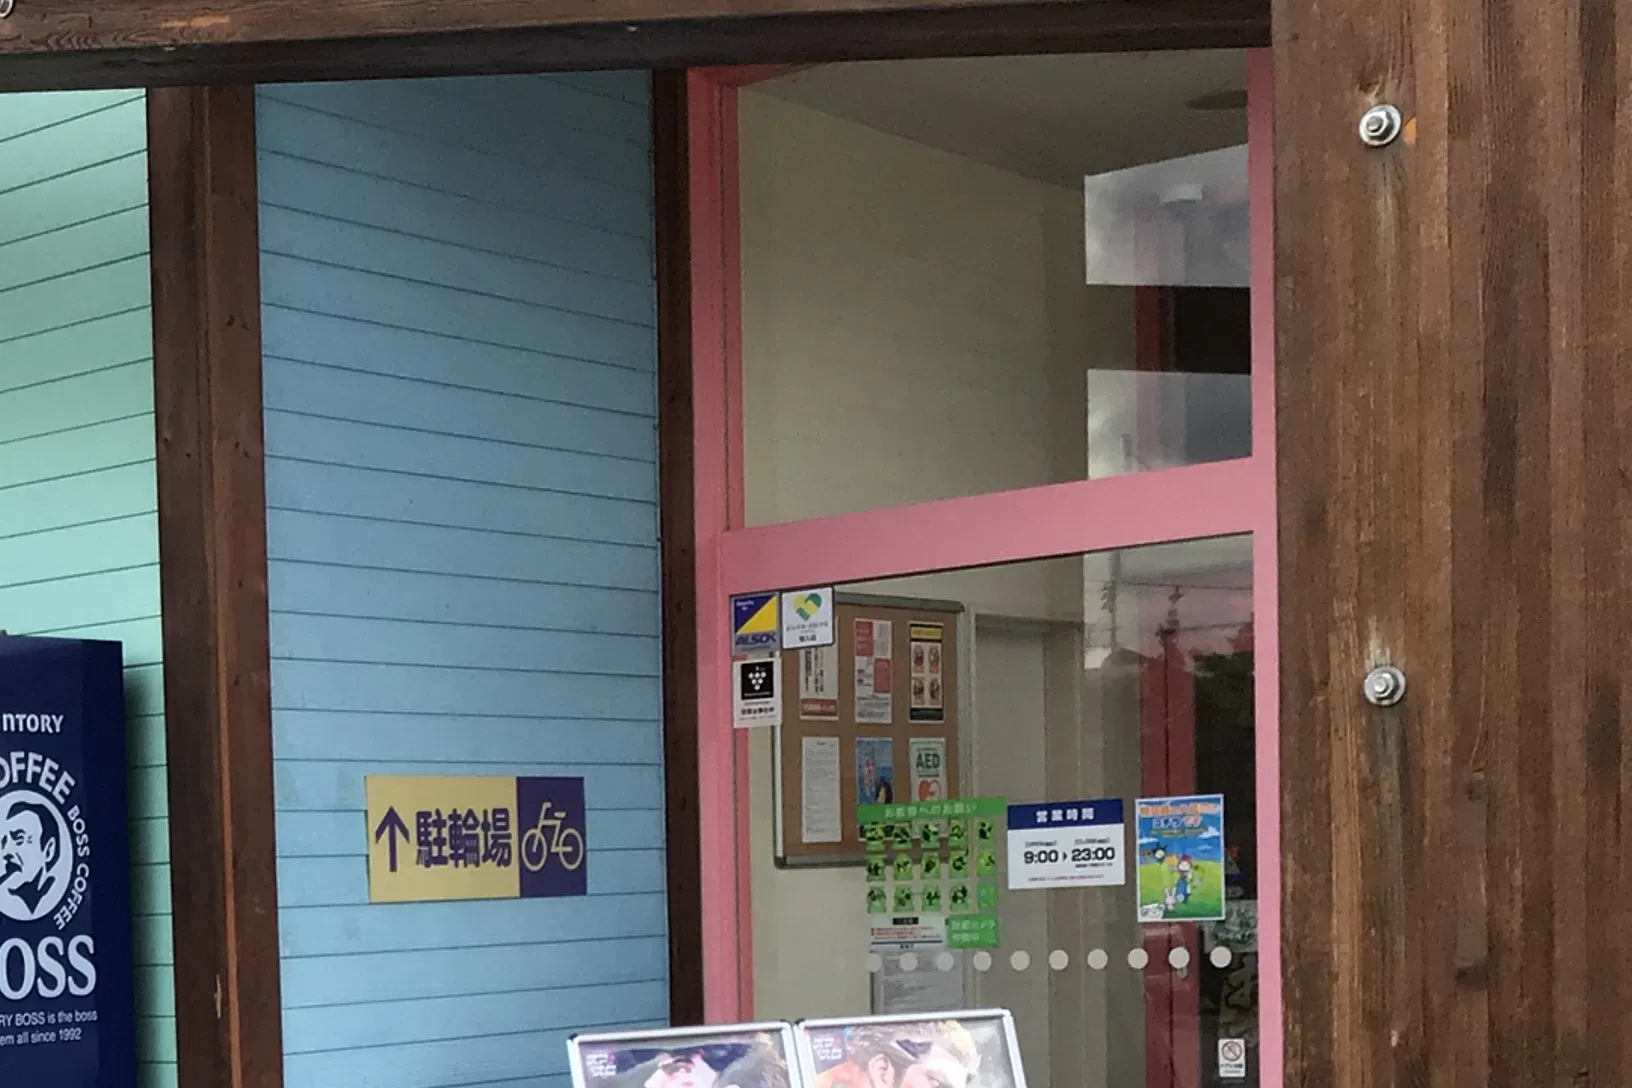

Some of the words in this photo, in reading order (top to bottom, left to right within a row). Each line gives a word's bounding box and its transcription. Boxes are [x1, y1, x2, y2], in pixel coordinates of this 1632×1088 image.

[916, 752, 940, 769] AED
[1036, 807, 1095, 823] 営業時間
[67, 804, 90, 858] BOSS
[415, 807, 513, 868] 駐輪場
[1023, 850, 1059, 864] 9:00
[1071, 847, 1116, 863] 23:00
[53, 862, 90, 931] COFFEE
[15, 1012, 45, 1028] BOSS
[47, 1011, 56, 1025] is
[57, 1010, 74, 1024] the
[75, 1008, 98, 1023] boss
[17, 1030, 29, 1045] all
[31, 1029, 56, 1044] since
[58, 1027, 83, 1043] 1992
